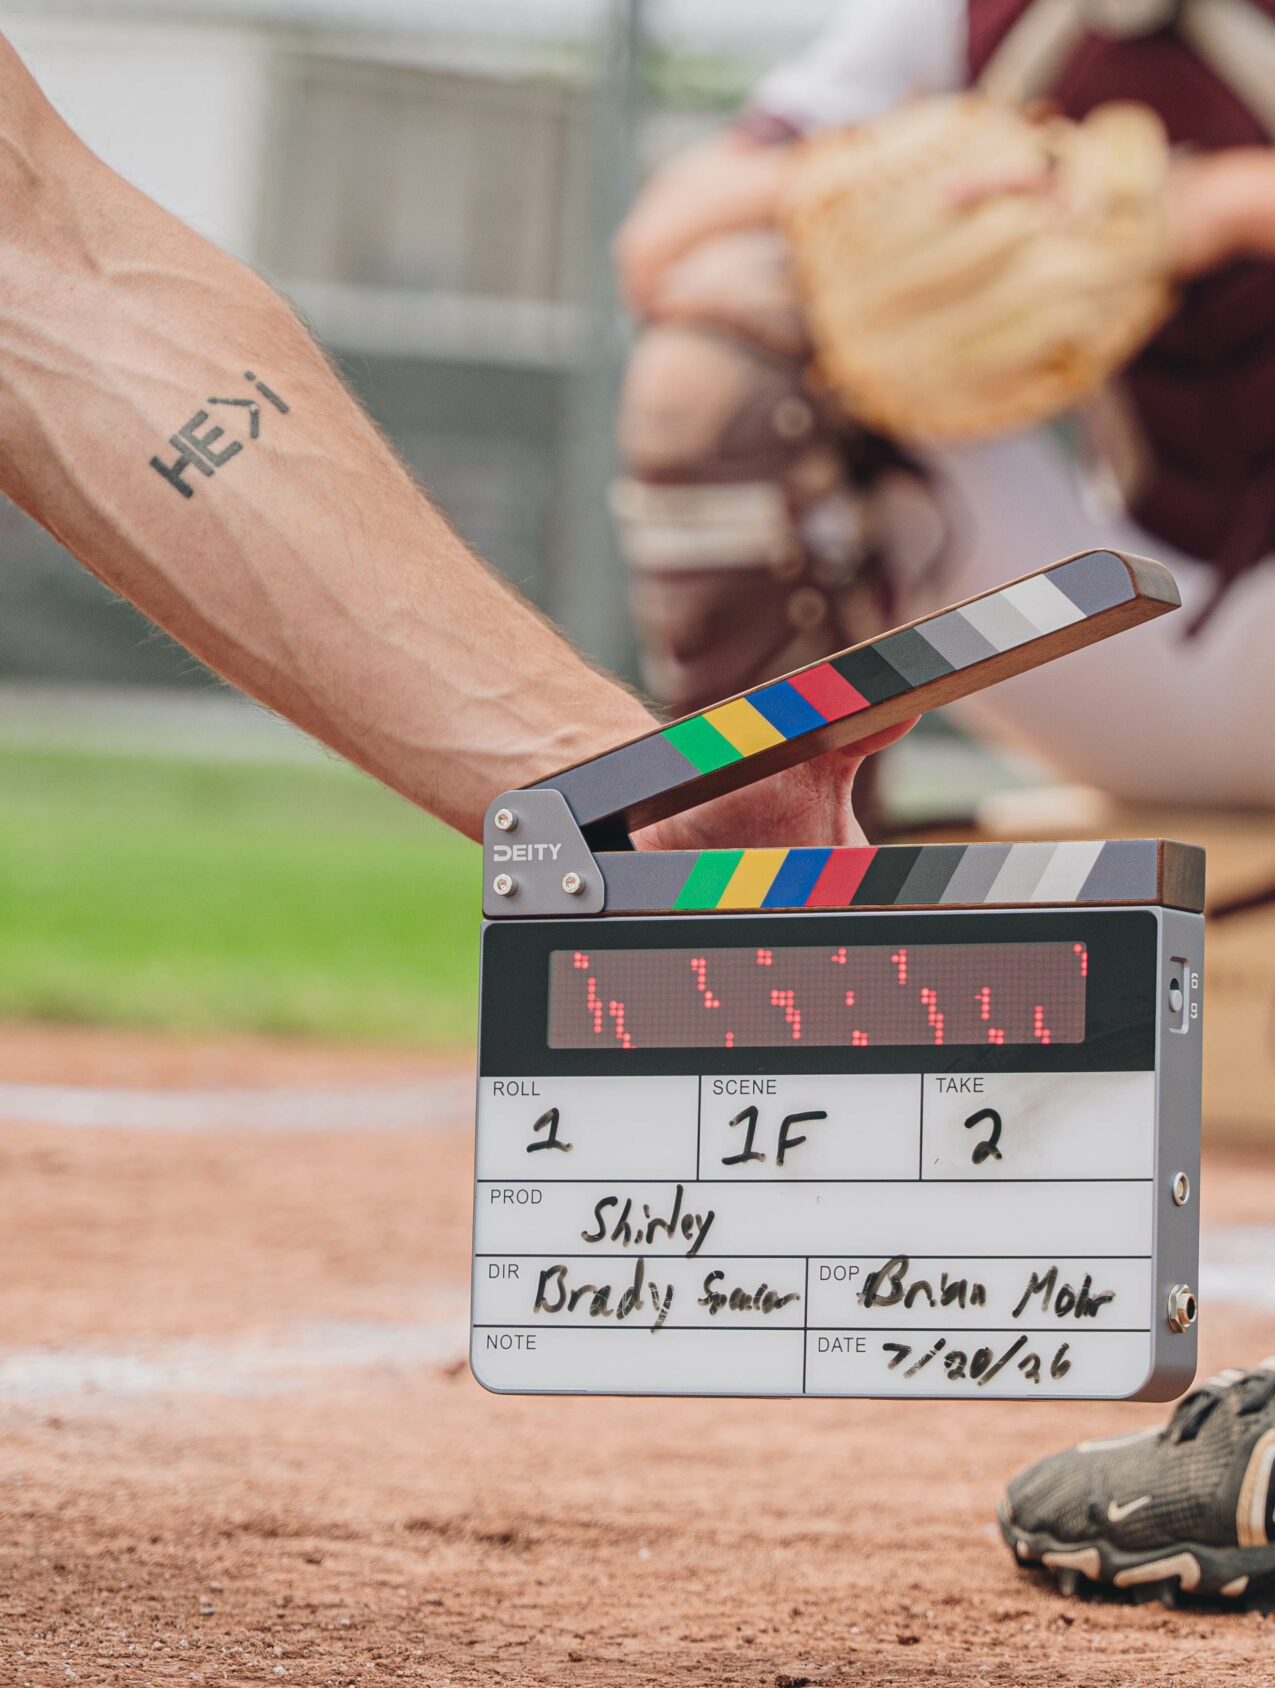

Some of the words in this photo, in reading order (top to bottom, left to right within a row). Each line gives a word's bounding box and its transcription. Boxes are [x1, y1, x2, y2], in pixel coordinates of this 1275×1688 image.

[493, 842, 562, 862] DEITY
[493, 1080, 541, 1097] ROLL
[712, 1079, 777, 1096] SCENE
[936, 1077, 985, 1094] TAKE
[526, 1107, 574, 1153] 1
[721, 1105, 828, 1167] 1F
[964, 1107, 1003, 1165] 2
[490, 1188, 543, 1205] PROD
[581, 1184, 716, 1258] Shirley
[488, 1263, 520, 1280] DIR
[819, 1265, 860, 1282] DOP
[857, 1254, 987, 1310] Brian
[533, 1256, 675, 1333] Brady
[486, 1334, 537, 1351] NOTE
[817, 1336, 867, 1353] DATE
